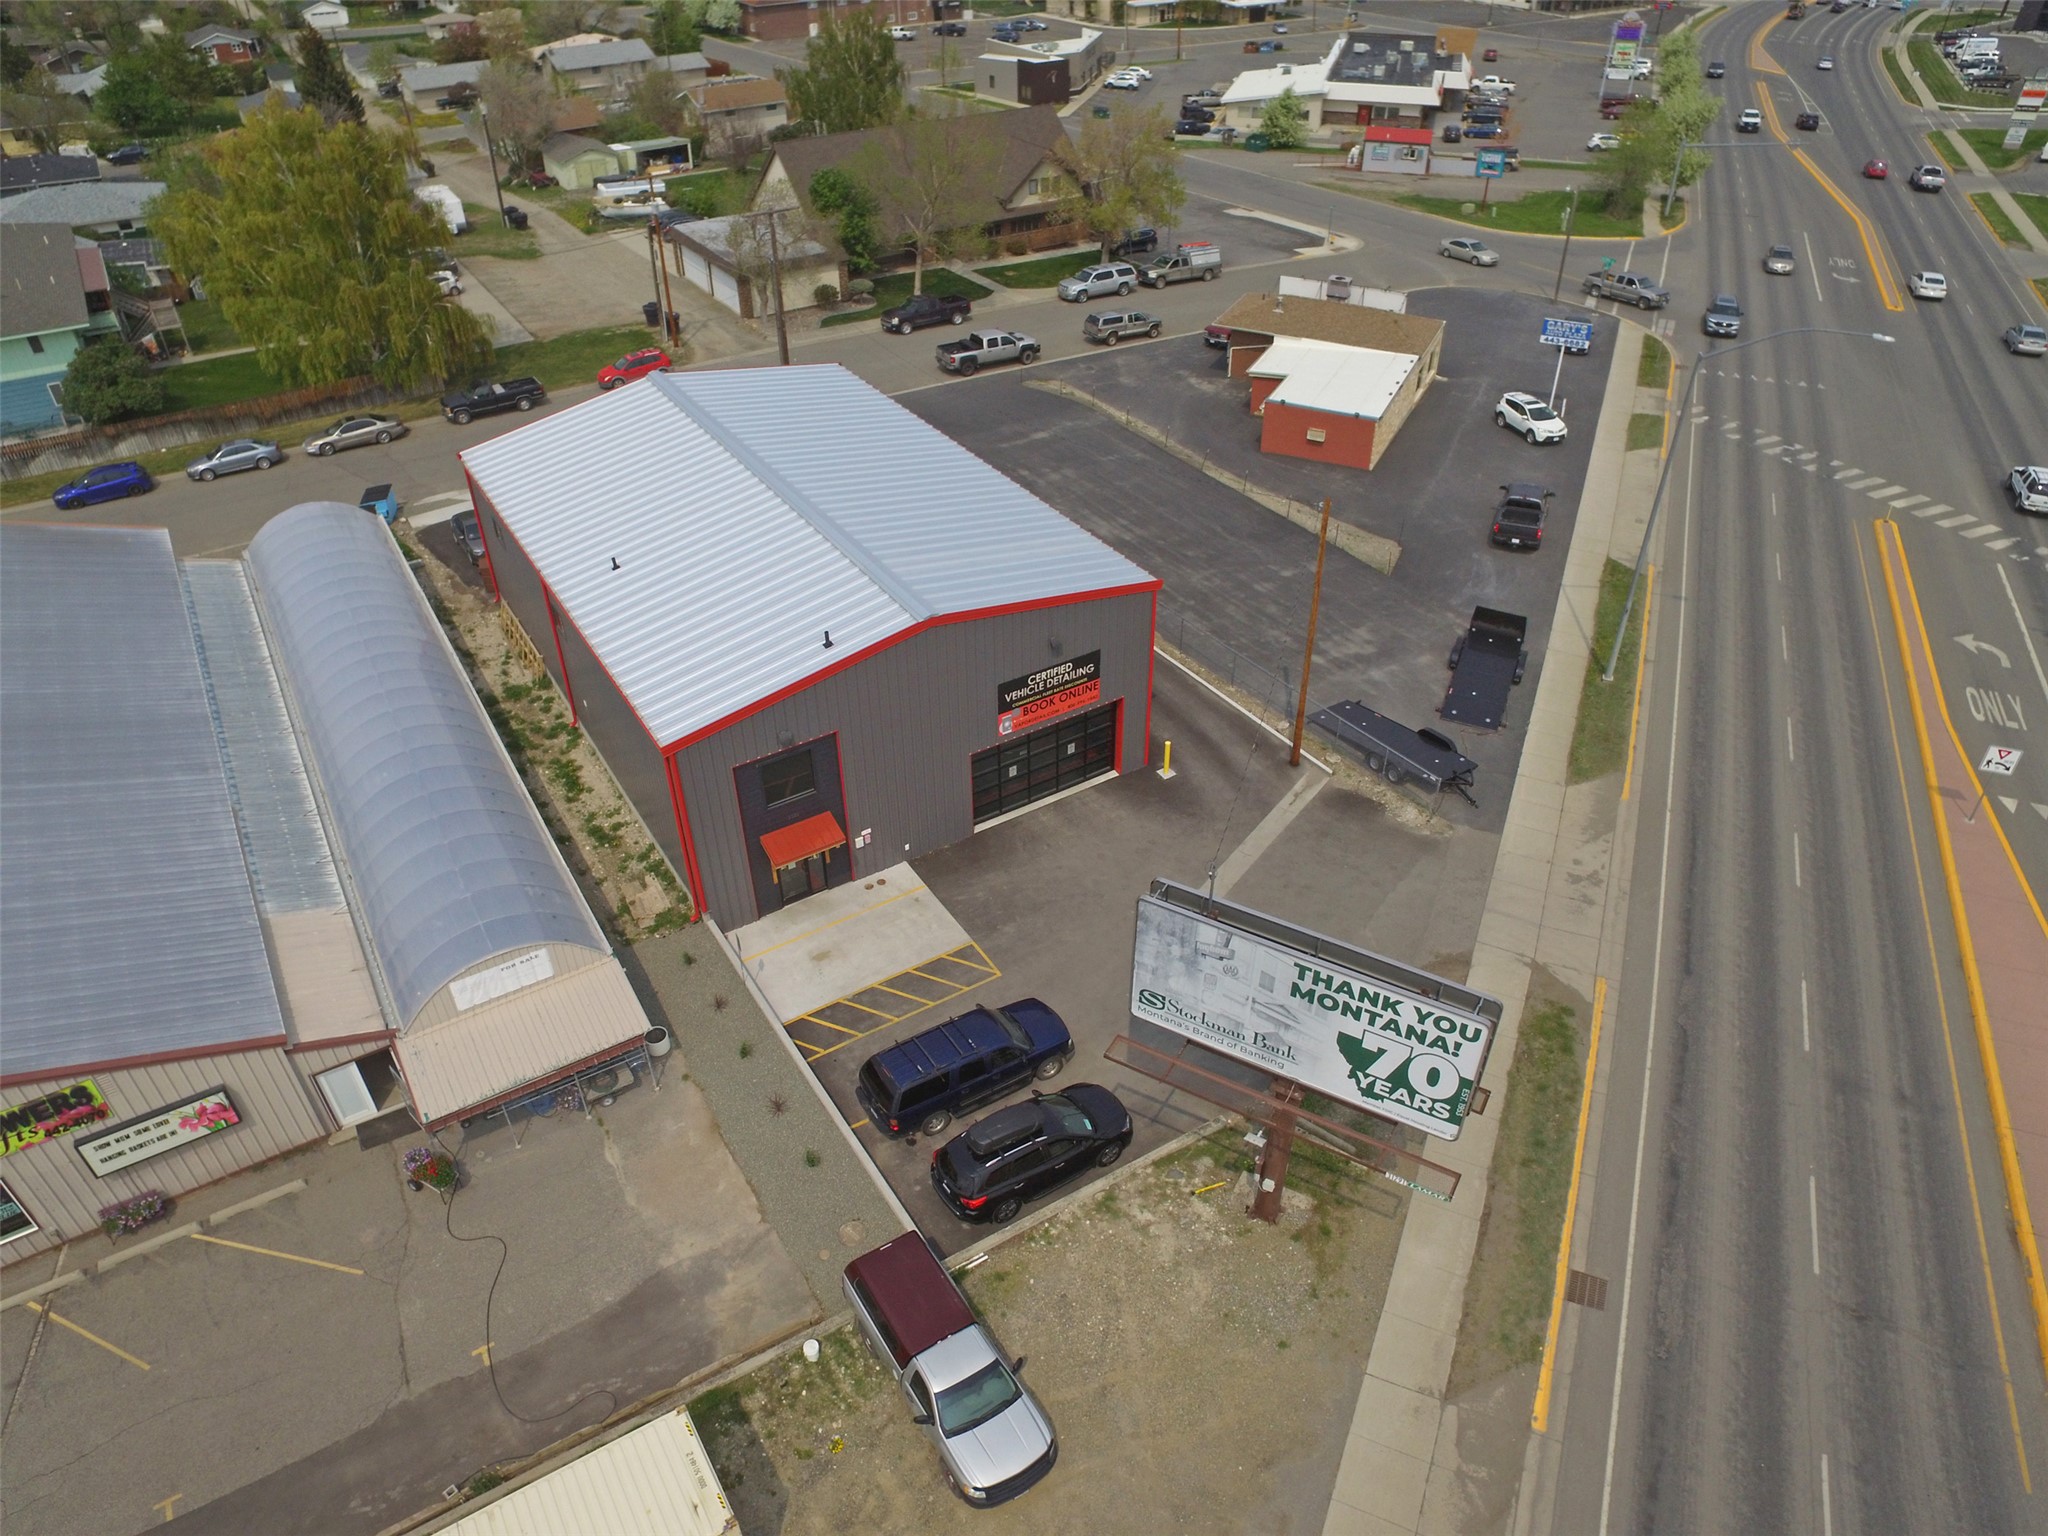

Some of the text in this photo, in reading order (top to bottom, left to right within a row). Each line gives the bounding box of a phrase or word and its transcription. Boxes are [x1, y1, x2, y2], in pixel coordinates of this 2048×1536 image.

[1828, 257, 1856, 269] ONLY
[1004, 681, 1045, 703] VEHICLE
[1046, 663, 1095, 688] DETAILING
[1027, 662, 1073, 685] CERTIFIED
[1023, 697, 1056, 717] BOOK
[1059, 680, 1099, 703] ONLINE
[1965, 686, 2028, 731] ONLY
[500, 962, 516, 972] FOR
[1290, 982, 1463, 1058] MONTANA!
[1293, 962, 1482, 1043] THANK YOU
[1137, 1004, 1285, 1070] Montana's Brand of Banking
[1166, 998, 1297, 1062] Stockman Bank
[1361, 1029, 1461, 1100] 70
[1356, 1070, 1451, 1119] YEARS
[128, 1138, 156, 1152] BASKETS
